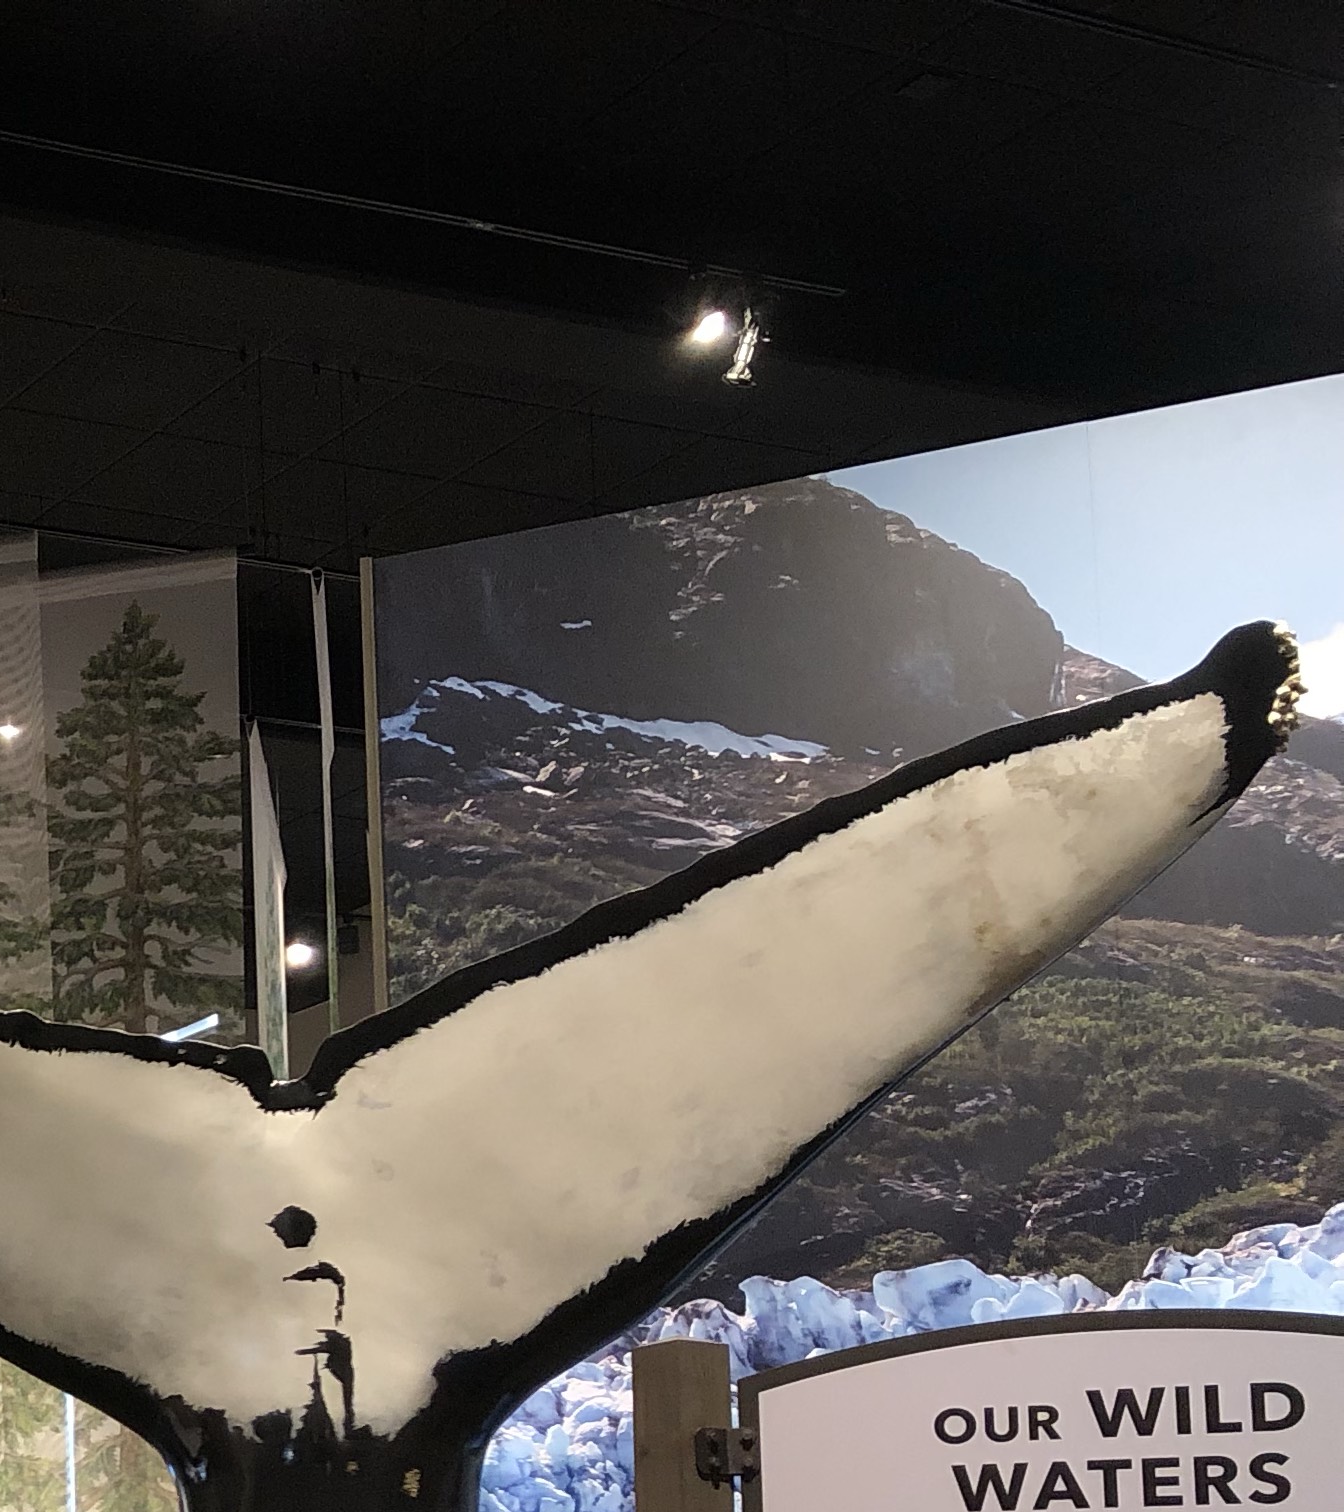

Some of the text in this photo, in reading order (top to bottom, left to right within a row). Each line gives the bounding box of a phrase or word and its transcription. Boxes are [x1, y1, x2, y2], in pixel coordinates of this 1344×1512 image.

[934, 1382, 1305, 1444] OUR WILD
[951, 1453, 1291, 1512] WATERS
